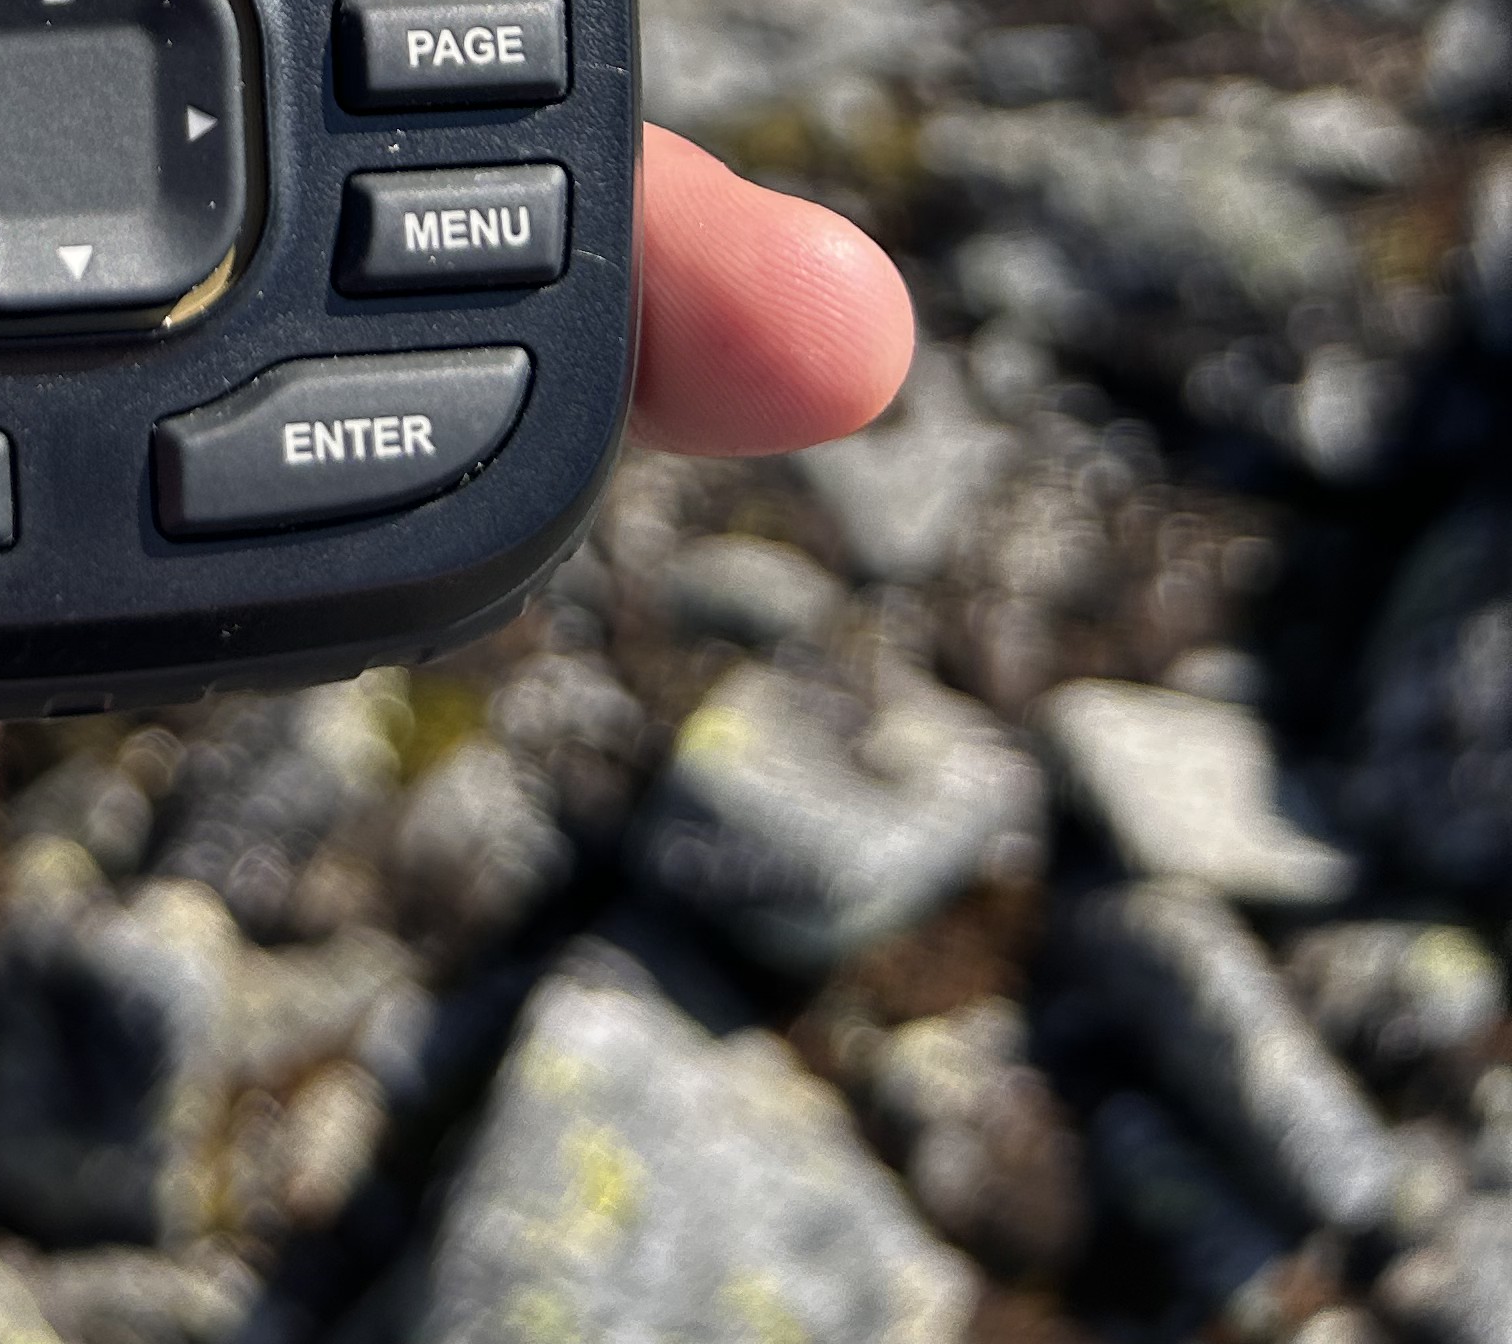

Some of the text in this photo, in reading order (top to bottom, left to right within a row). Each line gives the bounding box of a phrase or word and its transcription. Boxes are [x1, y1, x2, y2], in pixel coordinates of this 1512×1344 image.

[407, 25, 526, 69] PAGE
[404, 205, 531, 252] MENU
[283, 414, 437, 465] ENTER
